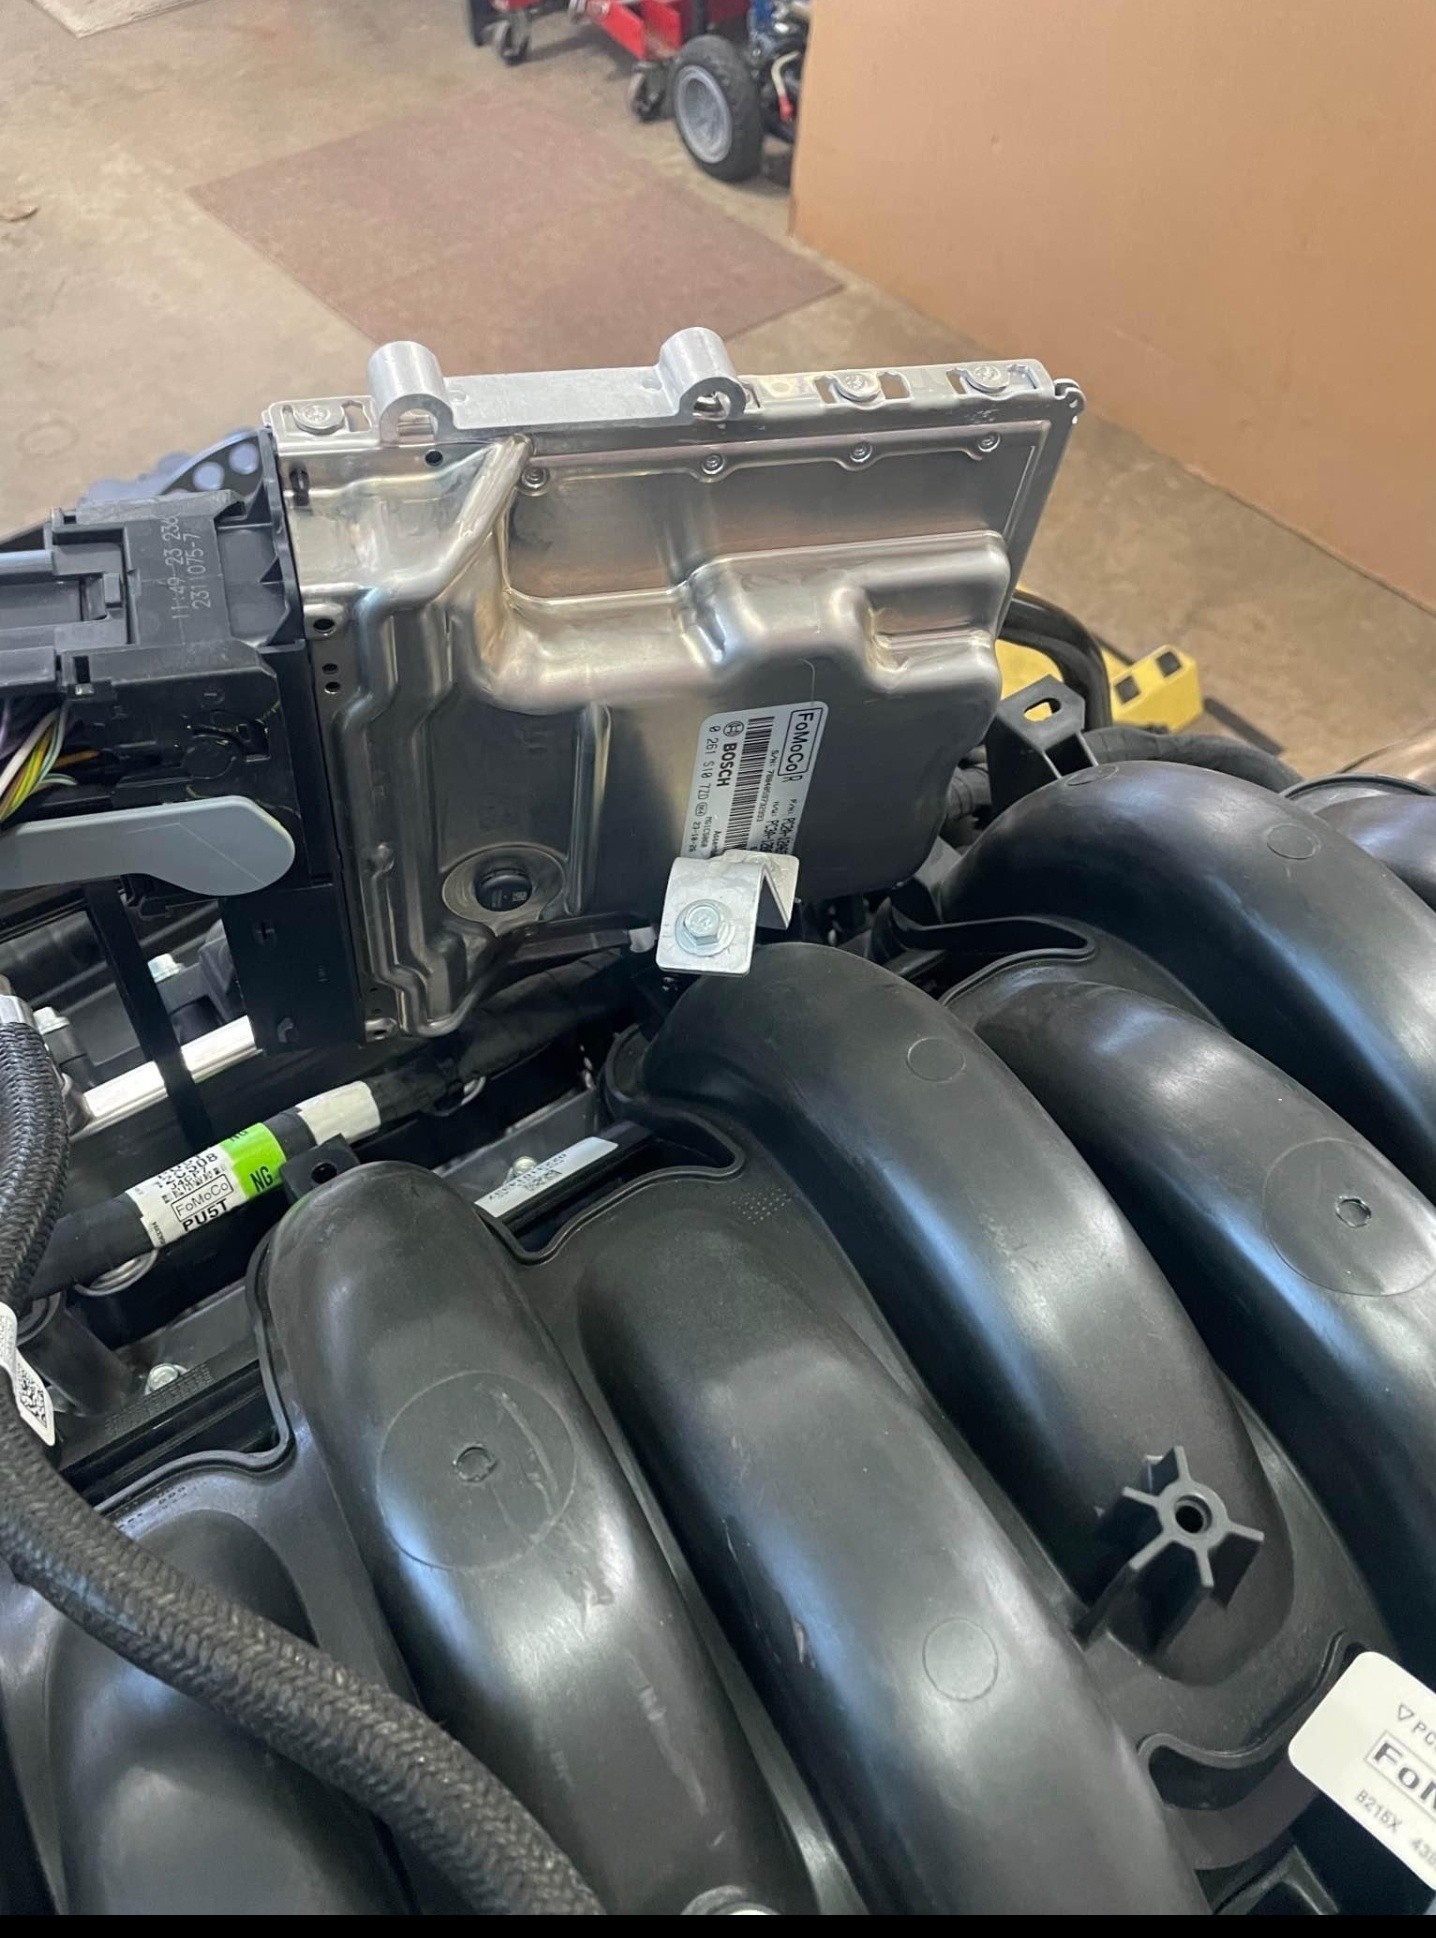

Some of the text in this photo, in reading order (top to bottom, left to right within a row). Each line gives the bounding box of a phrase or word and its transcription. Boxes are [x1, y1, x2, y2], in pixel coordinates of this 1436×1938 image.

[163, 548, 184, 566] 23
[705, 738, 719, 755] 261
[785, 712, 814, 772] FoMoCo
[716, 742, 738, 787] BOSCH
[250, 1165, 274, 1193] NG
[175, 1182, 229, 1216] FoMoCo
[182, 1198, 229, 1232] PU5T
